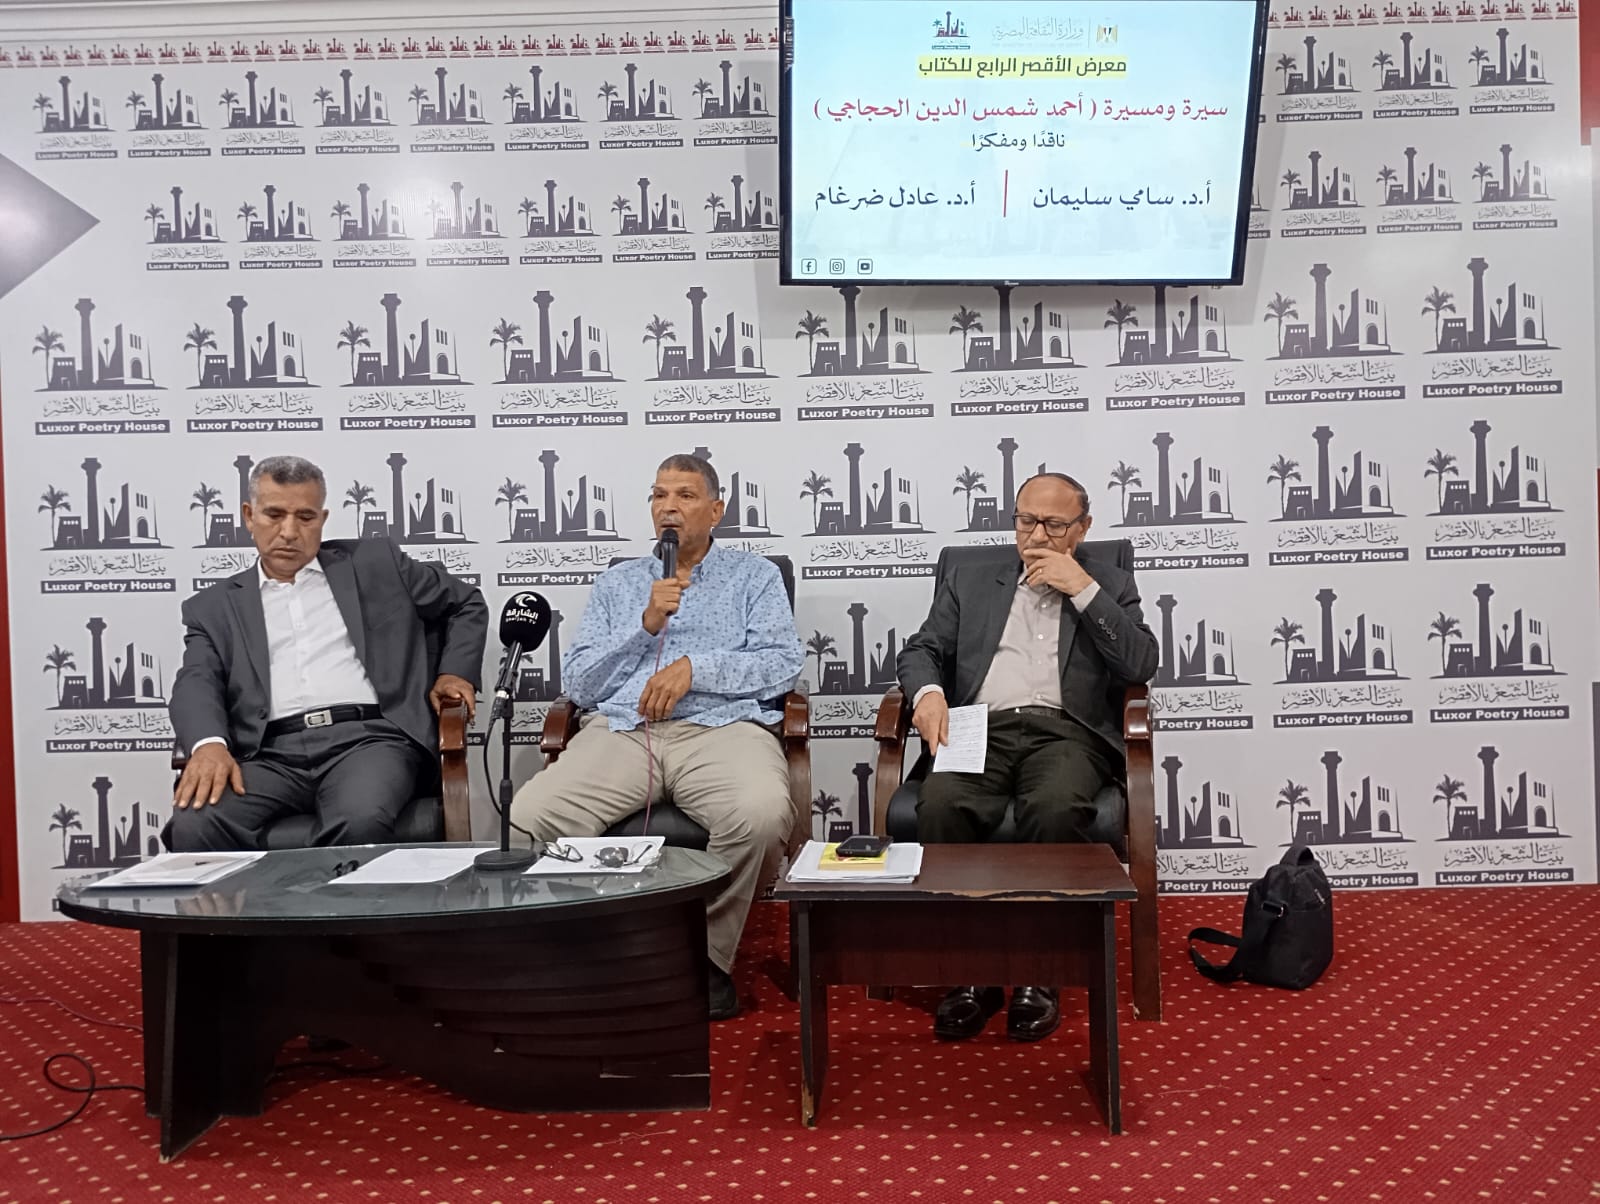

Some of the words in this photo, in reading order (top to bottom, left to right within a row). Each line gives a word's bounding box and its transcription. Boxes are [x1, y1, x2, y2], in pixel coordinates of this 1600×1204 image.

[918, 57, 972, 76] للكتاب
[976, 57, 1017, 78] الرابع
[1020, 55, 1071, 77] الأقصر
[1076, 57, 1126, 77] معرض
[827, 98, 910, 122] الحجاجي
[916, 98, 967, 122] الدين
[972, 98, 1039, 121] شمس
[1046, 92, 1083, 117] أحمد
[1103, 99, 1176, 121] ومسيرة
[1182, 99, 1228, 121] سيرة
[1304, 113, 1332, 121] Poetry
[1401, 109, 1428, 117] Poetry
[532, 142, 559, 150] Poetry
[626, 140, 653, 148] Poetry
[721, 137, 747, 145] Poetry
[749, 136, 775, 144] House
[815, 185, 884, 211] ضرغام
[889, 186, 939, 209] عادل
[1033, 186, 1113, 211] سليمان
[1119, 186, 1174, 211] سامي
[1308, 228, 1336, 236] Poetry
[1337, 226, 1364, 234] House
[1404, 224, 1432, 232] Poetry
[1500, 221, 1527, 229] Poetry
[546, 256, 573, 264] Poetry
[614, 254, 638, 262] Luxor
[733, 251, 760, 259] Poetry
[266, 261, 293, 269] Poetry
[1269, 391, 1308, 402] Luxor
[1311, 389, 1355, 401] Poetry
[1358, 387, 1401, 399] House
[1426, 385, 1465, 396] Luxor
[1468, 384, 1512, 395] Poetry
[1515, 382, 1558, 393] House
[955, 403, 993, 414] Luxor
[996, 402, 1039, 413] Poetry
[1042, 400, 1085, 411] House
[1109, 397, 1148, 408] Luxor
[1151, 396, 1195, 407] Poetry
[1198, 394, 1241, 405] House
[649, 412, 686, 422] Luxor
[689, 411, 732, 423] Poetry
[735, 410, 777, 420] House
[801, 408, 839, 418] Luxor
[842, 407, 885, 418] Poetry
[888, 406, 930, 416] House
[190, 421, 228, 430] Luxor
[231, 420, 274, 431] Poetry
[277, 419, 319, 429] House
[344, 418, 381, 428] Luxor
[384, 417, 427, 429] Poetry
[430, 417, 472, 427] House
[496, 415, 533, 425] Luxor
[536, 414, 579, 426] Poetry
[582, 413, 624, 424] House
[39, 423, 76, 432] Luxor
[79, 422, 121, 433] Poetry
[125, 421, 166, 431] House
[1273, 553, 1311, 563] Luxor
[1314, 551, 1358, 562] Poetry
[1362, 549, 1404, 560] House
[1430, 547, 1468, 558] Luxor
[1471, 546, 1515, 557] Poetry
[1519, 544, 1561, 555] House
[1134, 558, 1152, 569] xor
[1155, 557, 1199, 568] Poetry
[1202, 555, 1245, 566] House
[806, 568, 844, 578] Luxor
[847, 567, 890, 578] Poetry
[893, 565, 935, 576] House
[501, 574, 539, 584] Luxor
[542, 573, 585, 584] Poetry
[44, 582, 82, 591] Luxor
[85, 581, 127, 592] Poetry
[131, 580, 172, 590] House
[506, 608, 538, 620] الشارقة
[1277, 715, 1315, 725] Luxor
[1319, 713, 1362, 725] Poetry
[1366, 712, 1409, 722] House
[1434, 710, 1472, 720] Luxor
[1475, 709, 1519, 720] Poetry
[1523, 707, 1565, 718] House
[1159, 719, 1203, 730] Poetry
[1206, 718, 1249, 728] House
[810, 727, 846, 737] Luxor
[850, 727, 875, 736] Poe
[50, 741, 87, 750] Luxor
[90, 740, 133, 751] Poetry
[1372, 875, 1414, 885] House
[1439, 872, 1477, 883] Luxor
[1480, 871, 1524, 882] Poetry
[1527, 870, 1569, 880] House
[1164, 881, 1209, 892] Poetry
